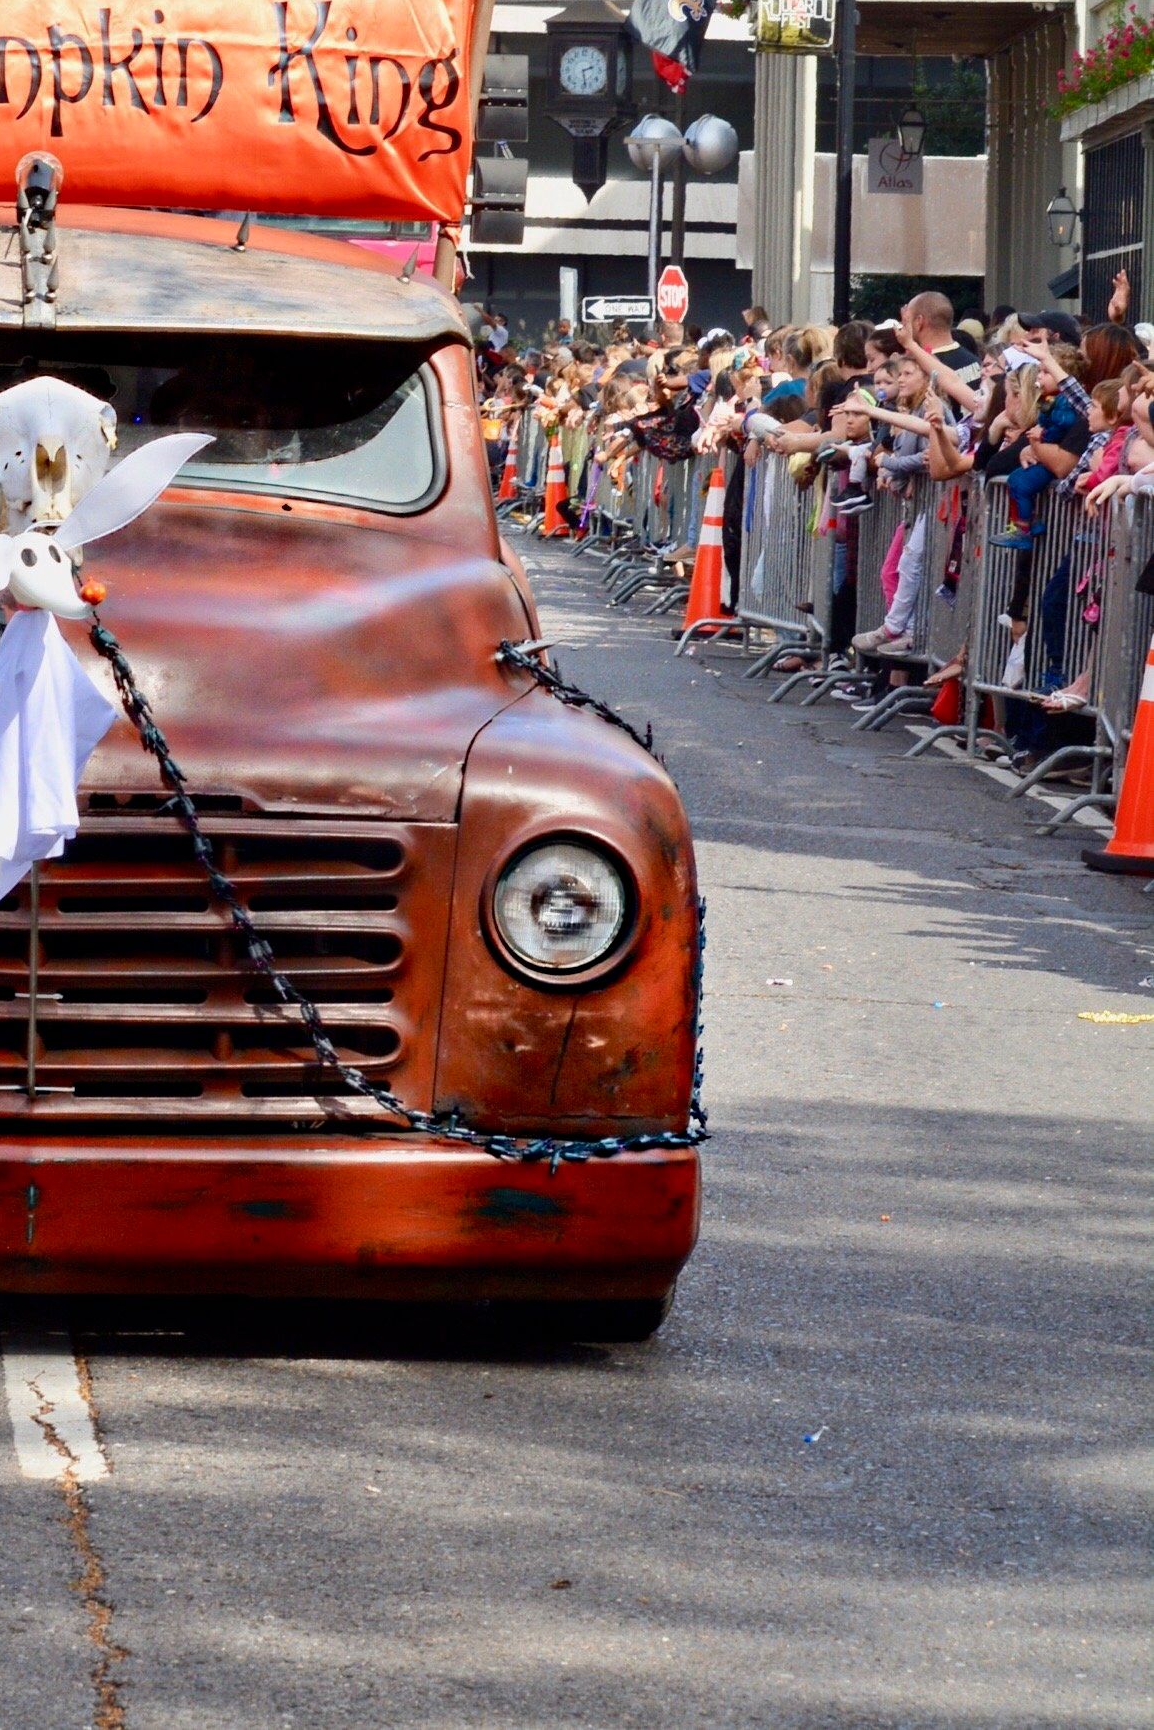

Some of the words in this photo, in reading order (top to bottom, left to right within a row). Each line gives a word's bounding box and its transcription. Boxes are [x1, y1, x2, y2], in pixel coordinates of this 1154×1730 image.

[780, 11, 812, 29] FEST
[268, 0, 462, 162] King
[660, 284, 687, 308] STOP
